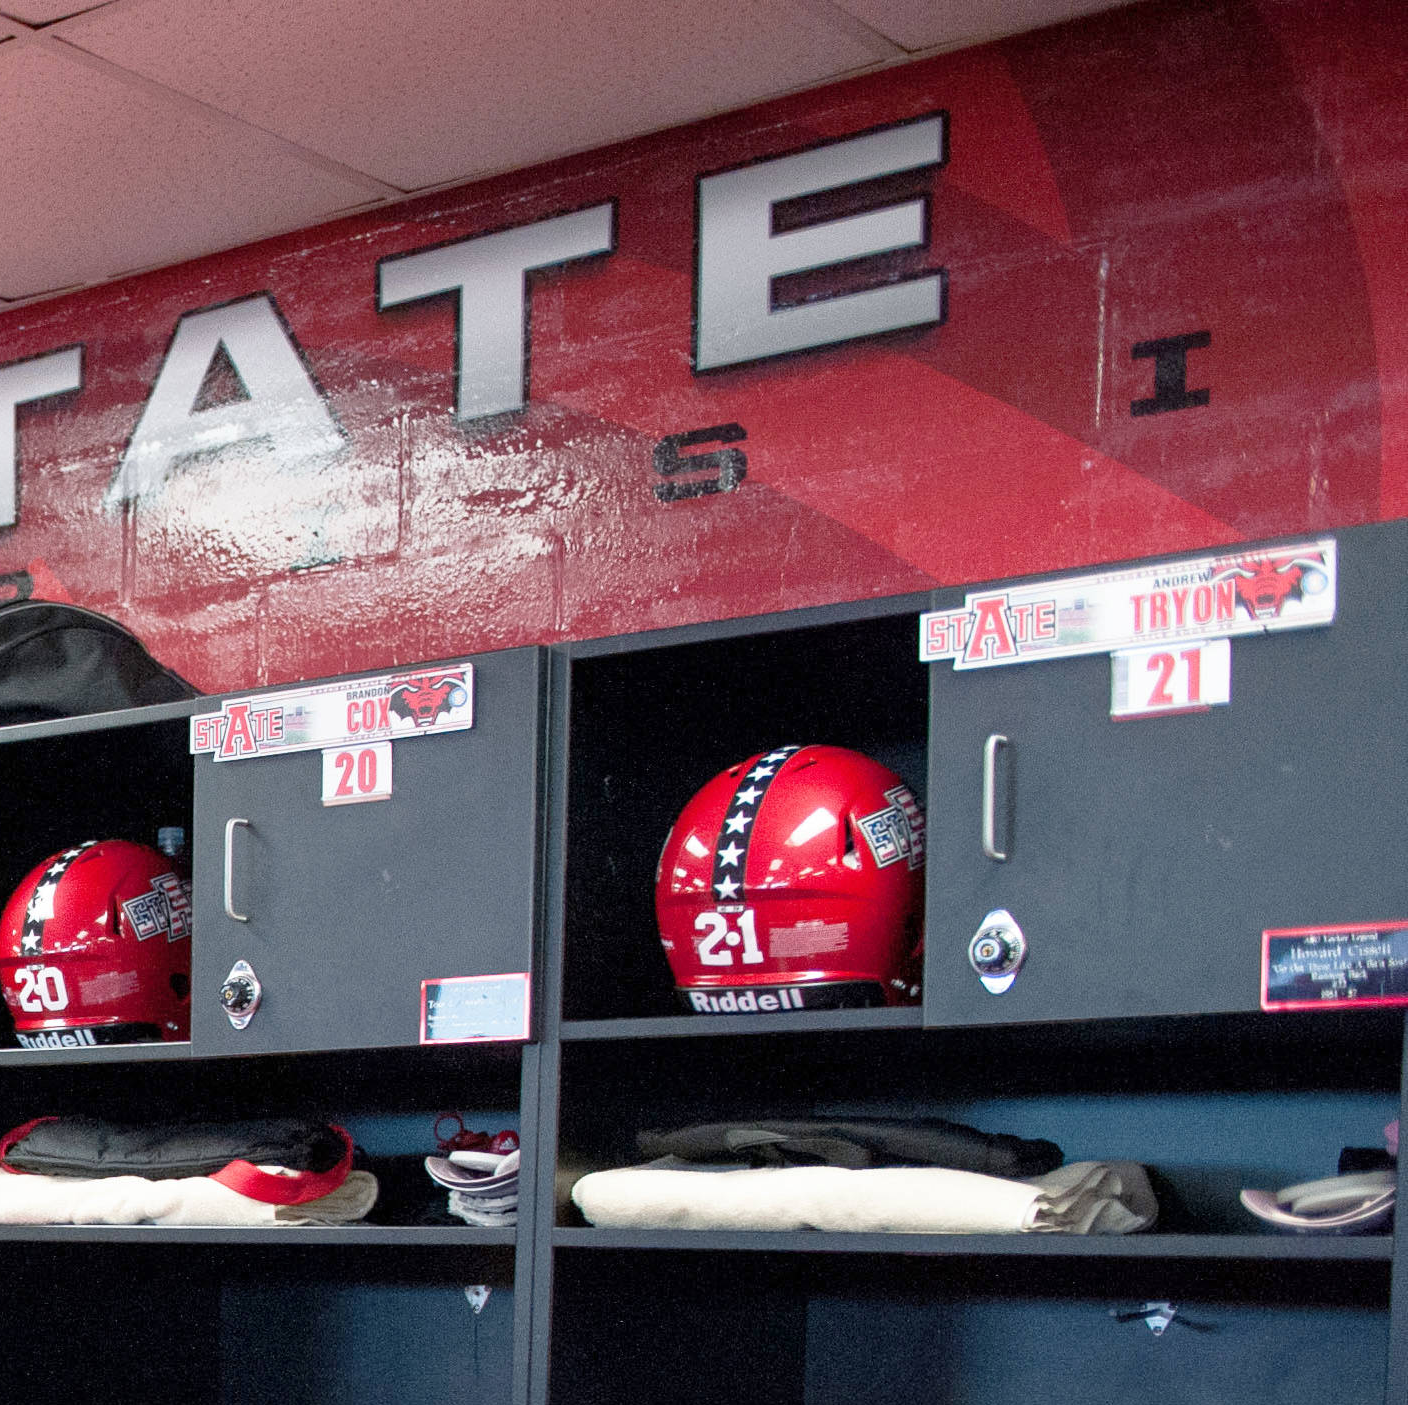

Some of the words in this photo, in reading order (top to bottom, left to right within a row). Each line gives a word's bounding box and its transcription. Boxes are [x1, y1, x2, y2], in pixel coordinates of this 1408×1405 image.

[1152, 568, 1213, 590] ANDREW
[926, 596, 1057, 662] STATE
[1129, 577, 1236, 634] TRYON
[346, 686, 391, 701] BRANDON
[1146, 647, 1202, 706] 21
[193, 705, 284, 756] STATE
[346, 696, 392, 734] COX
[334, 749, 379, 797] 20
[693, 909, 764, 966] 21
[14, 966, 68, 1013] 20
[688, 987, 805, 1013] Riddell
